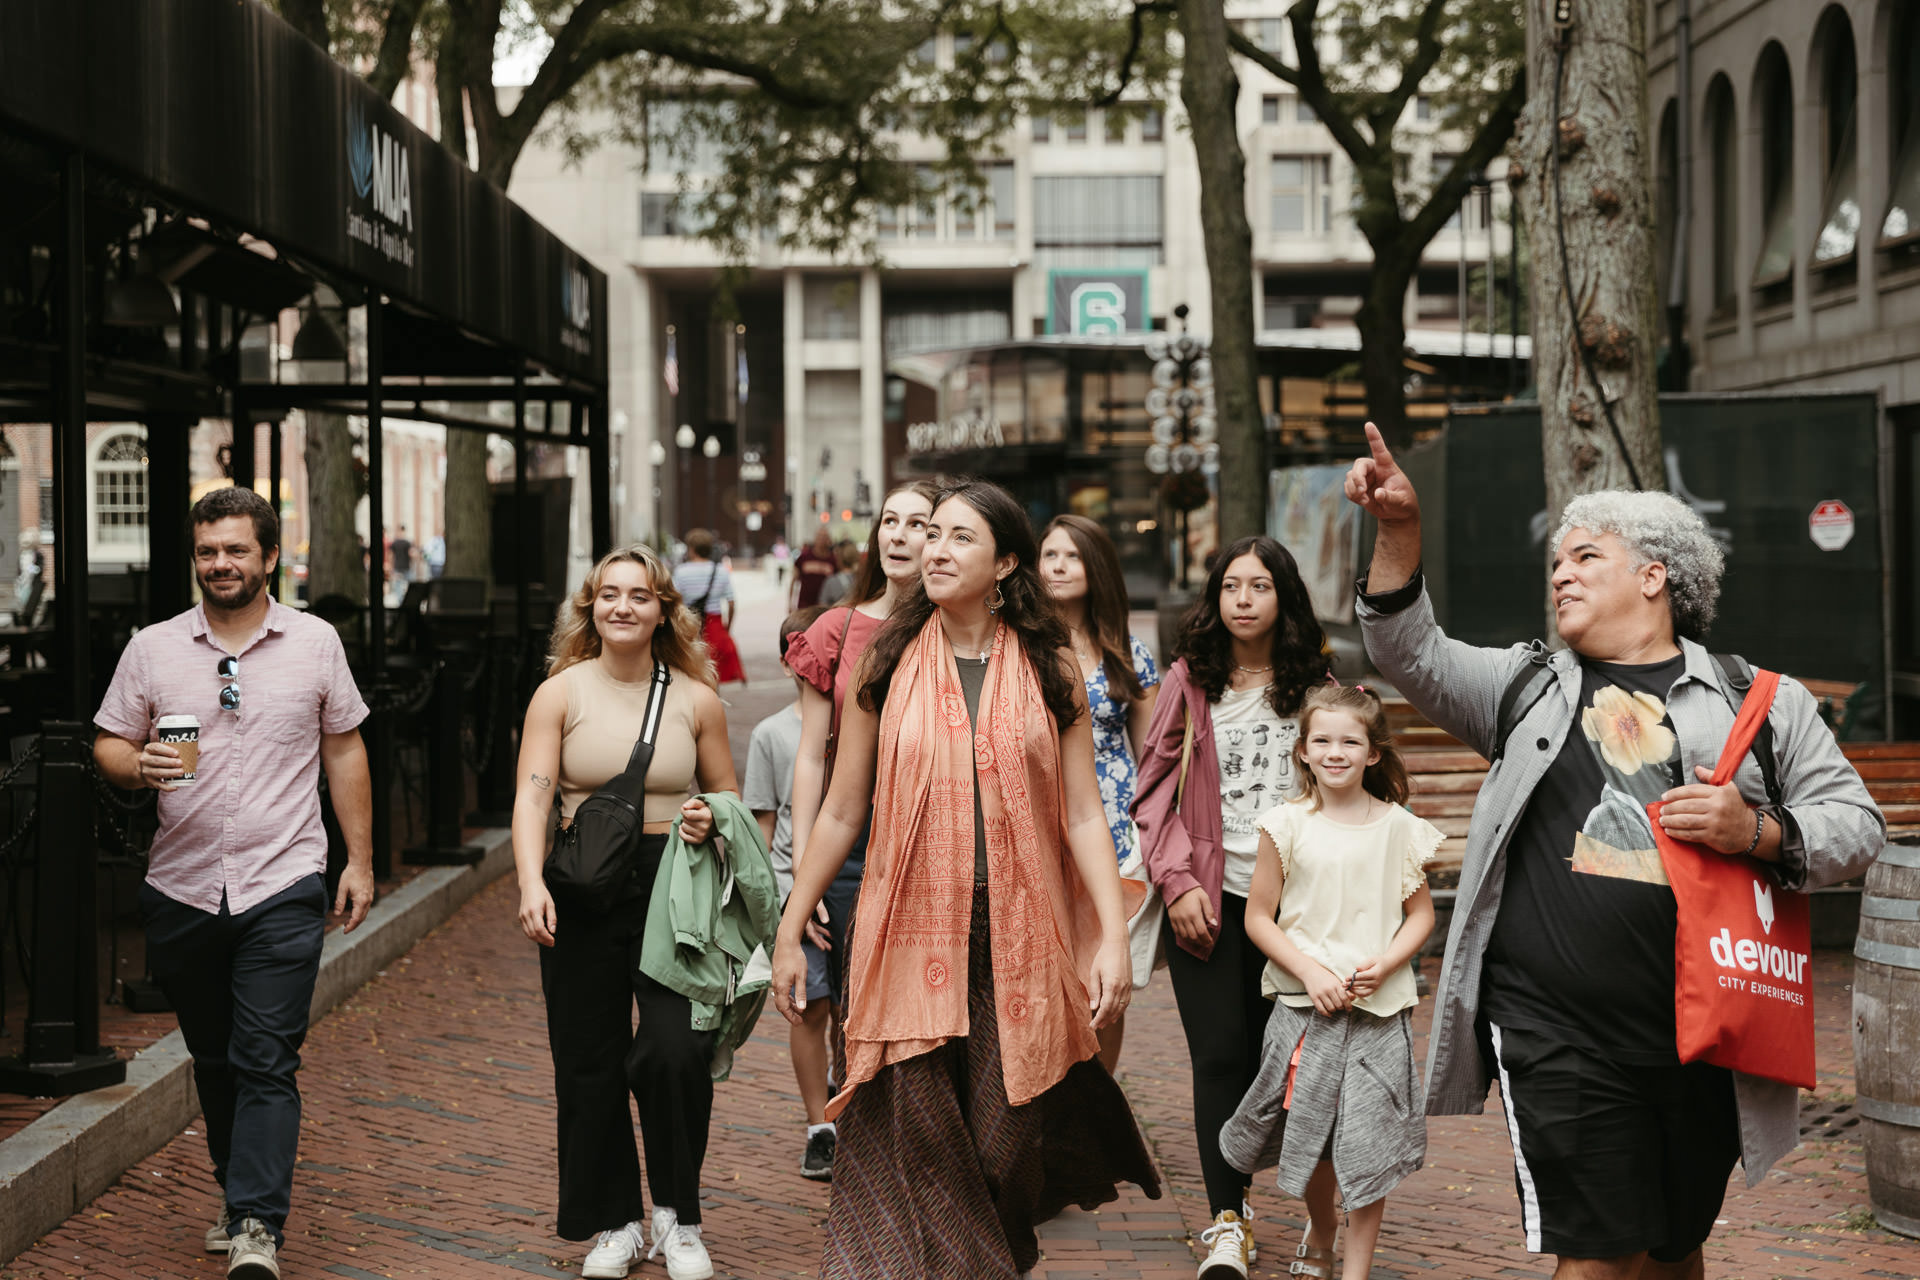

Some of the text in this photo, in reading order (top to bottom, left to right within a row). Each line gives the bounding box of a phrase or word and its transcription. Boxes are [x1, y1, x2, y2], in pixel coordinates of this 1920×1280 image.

[1710, 928, 1808, 984] devour
[1718, 976, 1804, 1006] CITY EXPERIENCES
